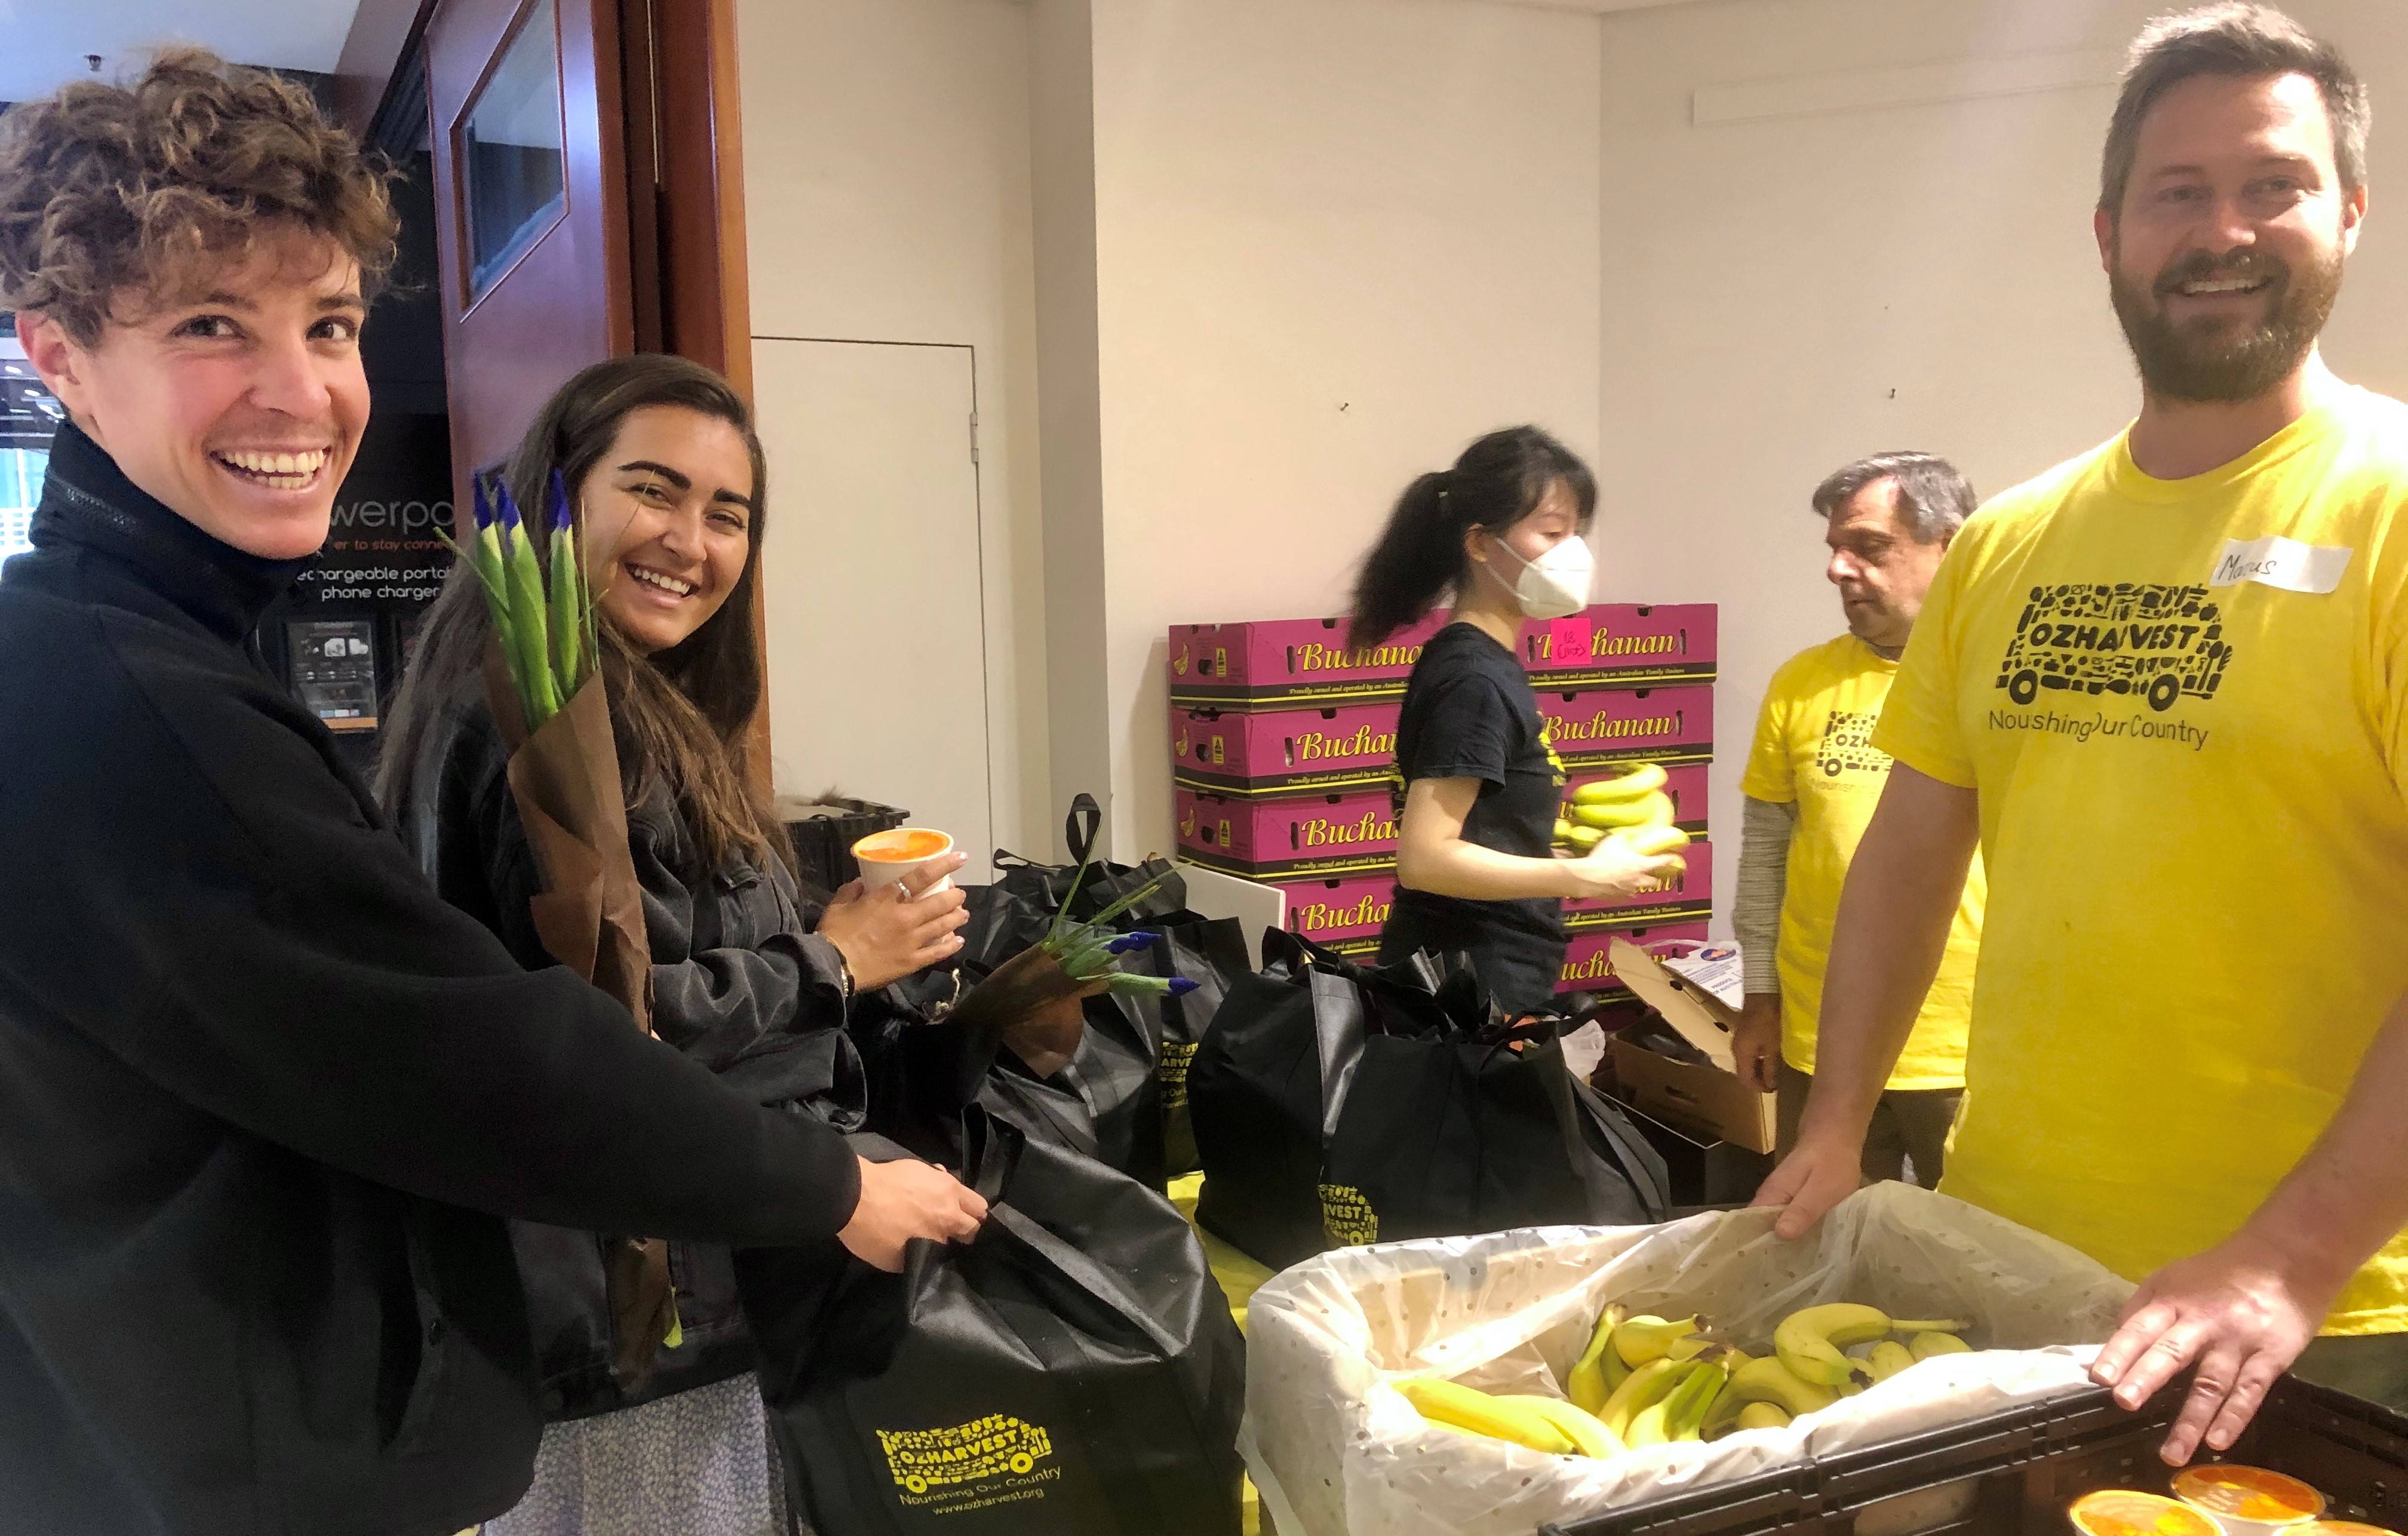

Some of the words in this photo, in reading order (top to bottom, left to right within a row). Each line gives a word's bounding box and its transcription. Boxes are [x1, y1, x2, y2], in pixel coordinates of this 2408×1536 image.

[355, 539, 368, 551] to
[372, 539, 400, 551] stay
[321, 586, 372, 602] phone
[377, 585, 440, 601] charger
[2029, 623, 2201, 652] OZHAVEST
[1542, 710, 1674, 742] Buchanan
[2130, 714, 2209, 751] Country
[899, 1488, 974, 1506] Nourishing
[1006, 1466, 1061, 1487] Country
